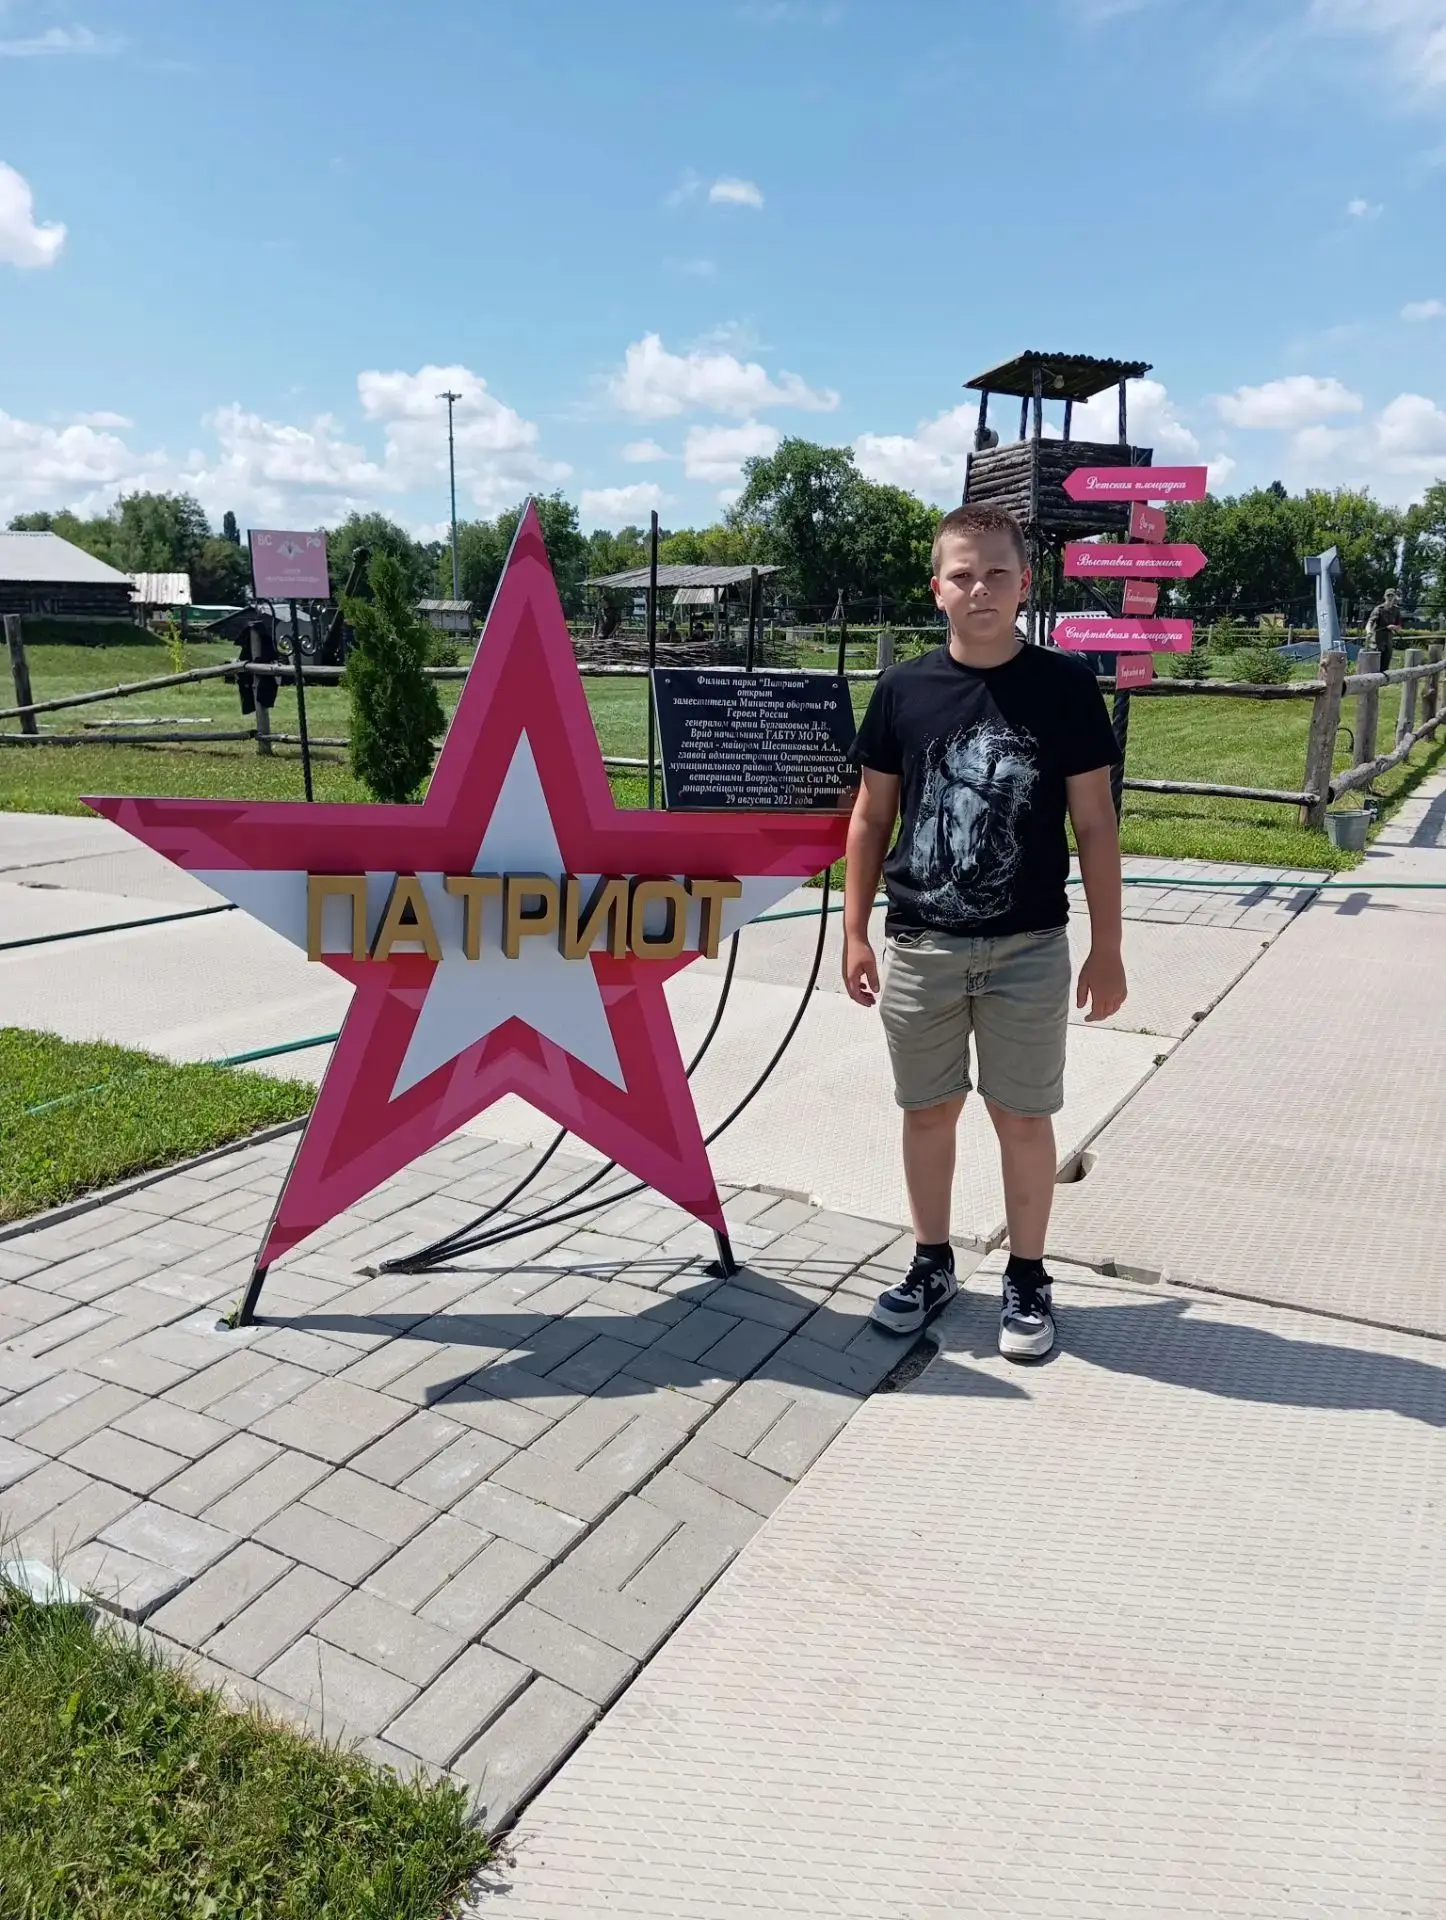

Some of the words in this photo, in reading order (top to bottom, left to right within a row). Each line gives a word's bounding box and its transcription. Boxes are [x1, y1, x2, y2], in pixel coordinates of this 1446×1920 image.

[1086, 476, 1132, 489] Детская
[1135, 481, 1186, 494] площадка
[257, 534, 273, 546] ВС
[1077, 553, 1132, 567] Выставка
[1135, 559, 1183, 567] техники
[1065, 627, 1130, 643] Спортивная
[1131, 633, 1183, 645] площадка
[697, 675, 730, 686] Филиал
[732, 678, 757, 688] парка
[760, 678, 809, 689] "Патриот"
[737, 689, 773, 699] открыт
[673, 697, 737, 706] заместителем
[740, 698, 784, 710] Министра
[786, 700, 821, 711] обороны
[823, 700, 837, 710] РФ
[727, 707, 757, 719] Героем
[760, 709, 788, 719] России
[685, 719, 728, 729] генералом
[731, 720, 758, 730] армии
[760, 720, 809, 731] Булгаковым
[691, 728, 712, 740] Врид
[714, 729, 764, 739] начальника
[766, 730, 796, 740] ГАБТУ
[799, 731, 814, 741] МО
[816, 731, 830, 741] РФ
[681, 740, 714, 750] генерал
[721, 740, 759, 751] майором
[761, 740, 818, 751] Шестаковым
[821, 742, 841, 753] А.А.,
[678, 750, 706, 760] главой
[708, 751, 778, 764] администрации
[780, 751, 847, 763] Острогожского
[668, 762, 741, 772] муниципального
[742, 763, 773, 773] района
[774, 762, 835, 774] Хорошиловым
[689, 773, 743, 783] ветеранами
[744, 772, 805, 785] Вооруженных
[806, 773, 823, 783] Сил
[681, 783, 744, 795] юнармейцами
[746, 784, 778, 795] отряда
[725, 794, 735, 804] 29
[737, 796, 772, 806] августа
[773, 794, 792, 805] 2021
[794, 796, 813, 805] года
[306, 871, 742, 962] ПАТРИОТ
